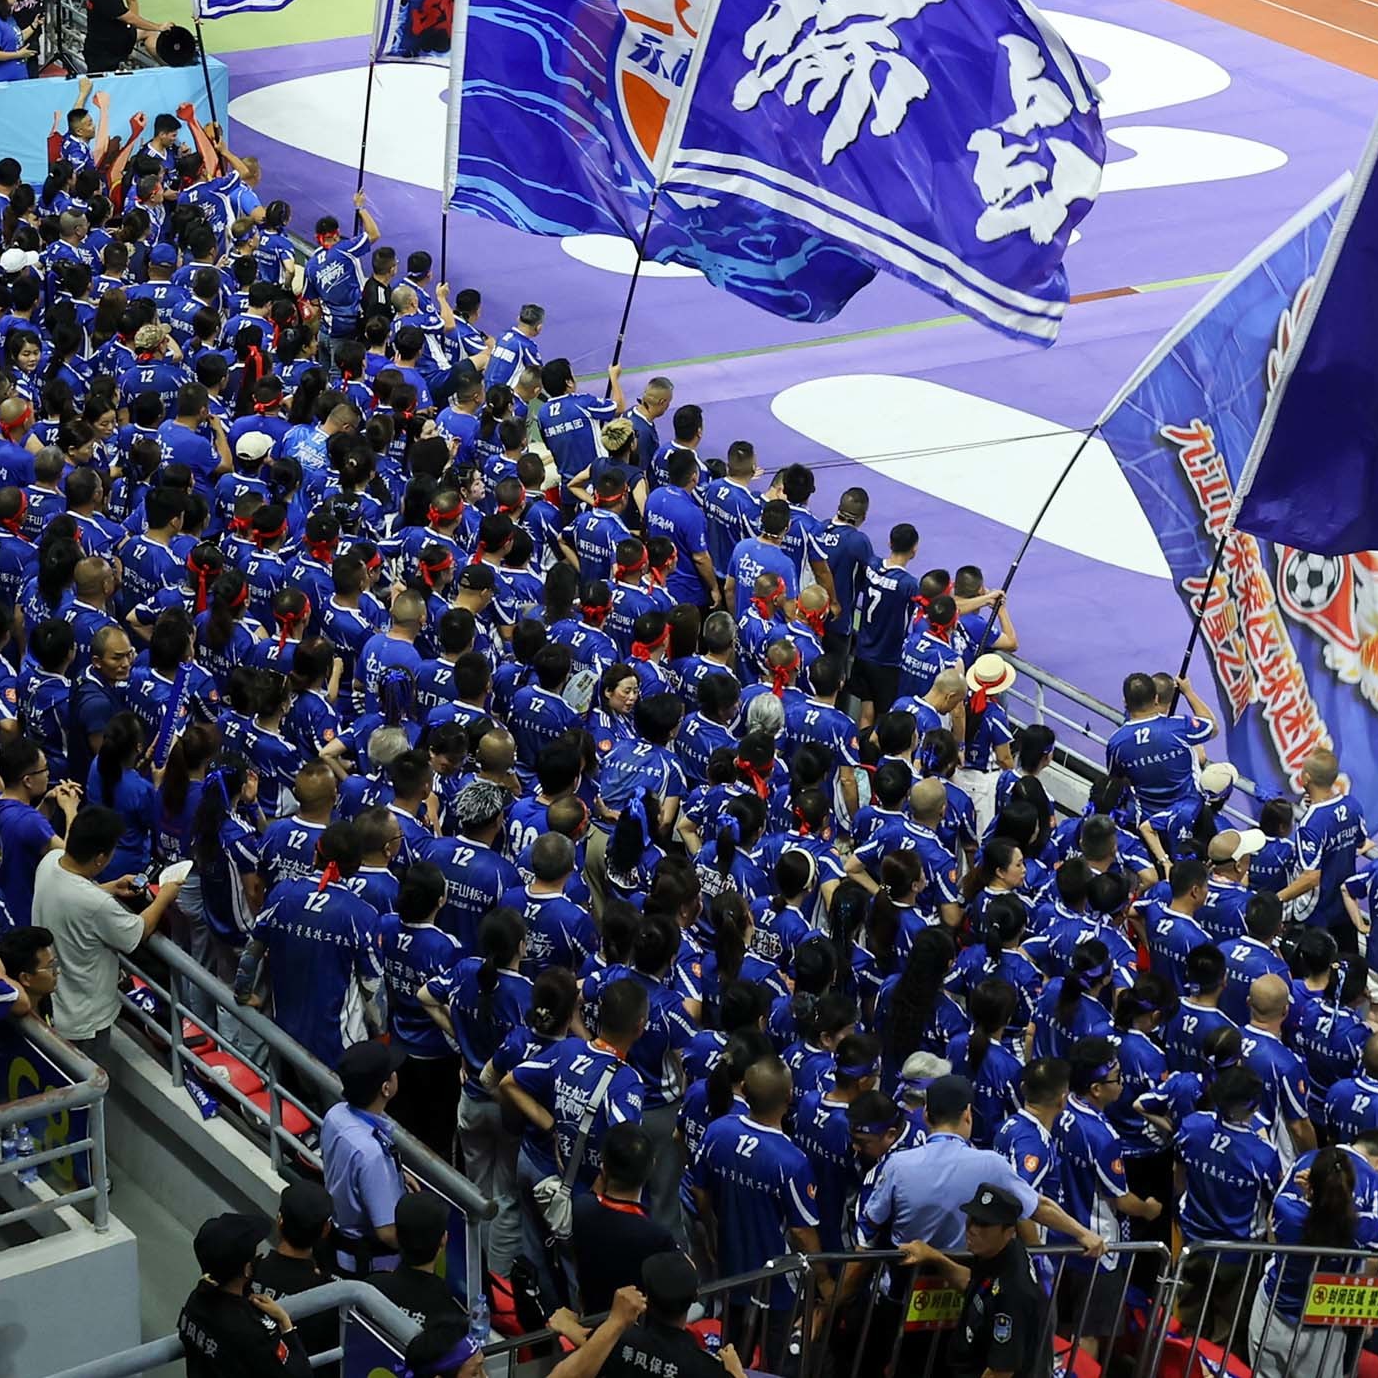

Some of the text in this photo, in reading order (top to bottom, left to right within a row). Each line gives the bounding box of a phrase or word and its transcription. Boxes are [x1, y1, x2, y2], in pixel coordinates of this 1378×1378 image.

[549, 401, 561, 417] 12
[715, 485, 729, 500] 12
[585, 517, 598, 533] 12
[867, 587, 882, 610] 7
[1161, 418, 1350, 795] 九江柴桑区球迷协
[571, 632, 586, 648] 12
[434, 668, 453, 684] 12
[692, 664, 708, 679] 12
[140, 678, 153, 696] 12
[531, 697, 546, 714] 12
[804, 709, 819, 726] 12
[685, 721, 699, 738] 12
[1134, 727, 1150, 745] 12
[633, 740, 651, 757] 12
[1333, 804, 1348, 822] 12
[288, 829, 309, 849] 12
[451, 845, 475, 866] 12
[303, 891, 330, 912] 12
[1157, 918, 1174, 935] 12
[397, 933, 413, 952] 12
[1231, 943, 1250, 961] 12
[1182, 1015, 1199, 1034] 12
[569, 1053, 593, 1076] 12
[1352, 1094, 1370, 1114] 12
[1060, 1110, 1075, 1132] 12
[735, 1134, 759, 1157] 12
[1210, 1132, 1232, 1154] 12
[1328, 1287, 1366, 1307] 封闭区域
